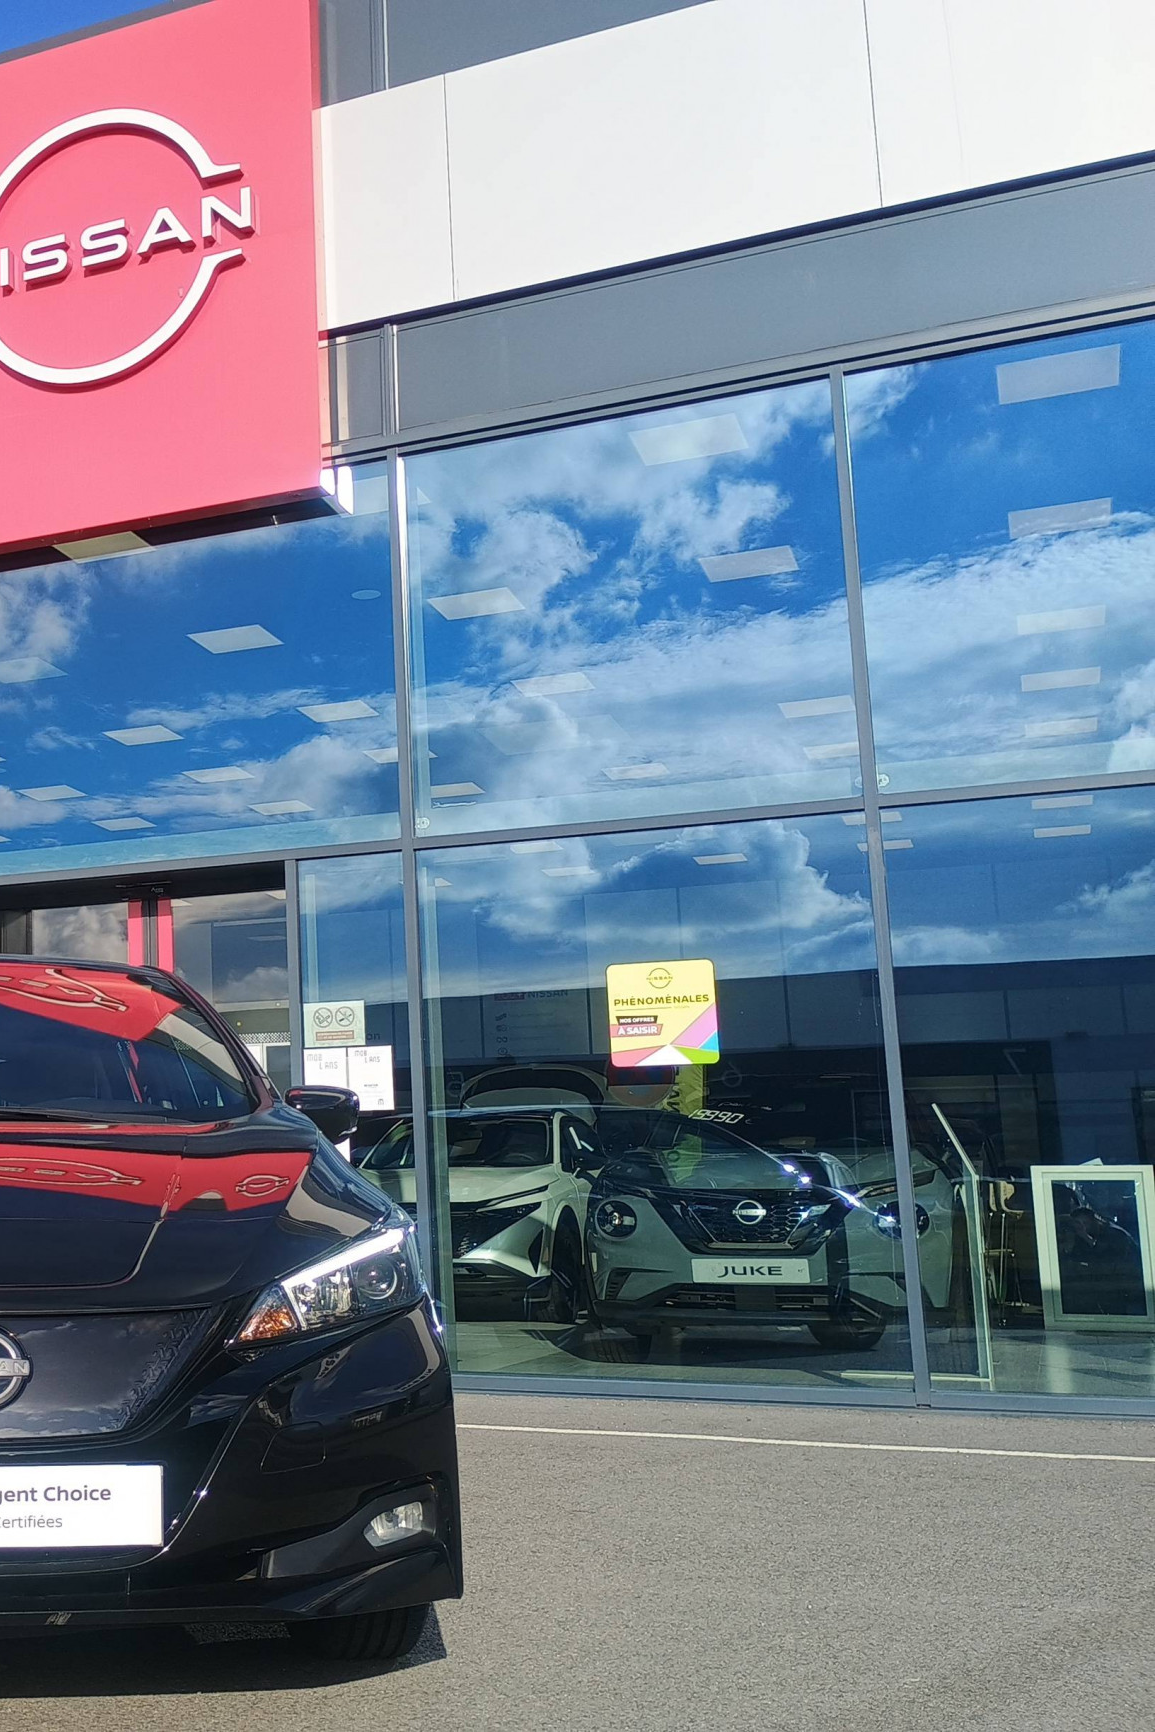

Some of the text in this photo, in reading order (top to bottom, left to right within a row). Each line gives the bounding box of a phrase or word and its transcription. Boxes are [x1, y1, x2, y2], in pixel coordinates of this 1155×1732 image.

[614, 994, 709, 1006] PHÉNOMÉNALES
[627, 1026, 657, 1035] SAISIR
[688, 1109, 744, 1124] 19990
[717, 1265, 783, 1278] JUKE
[43, 1485, 112, 1501] Choice
